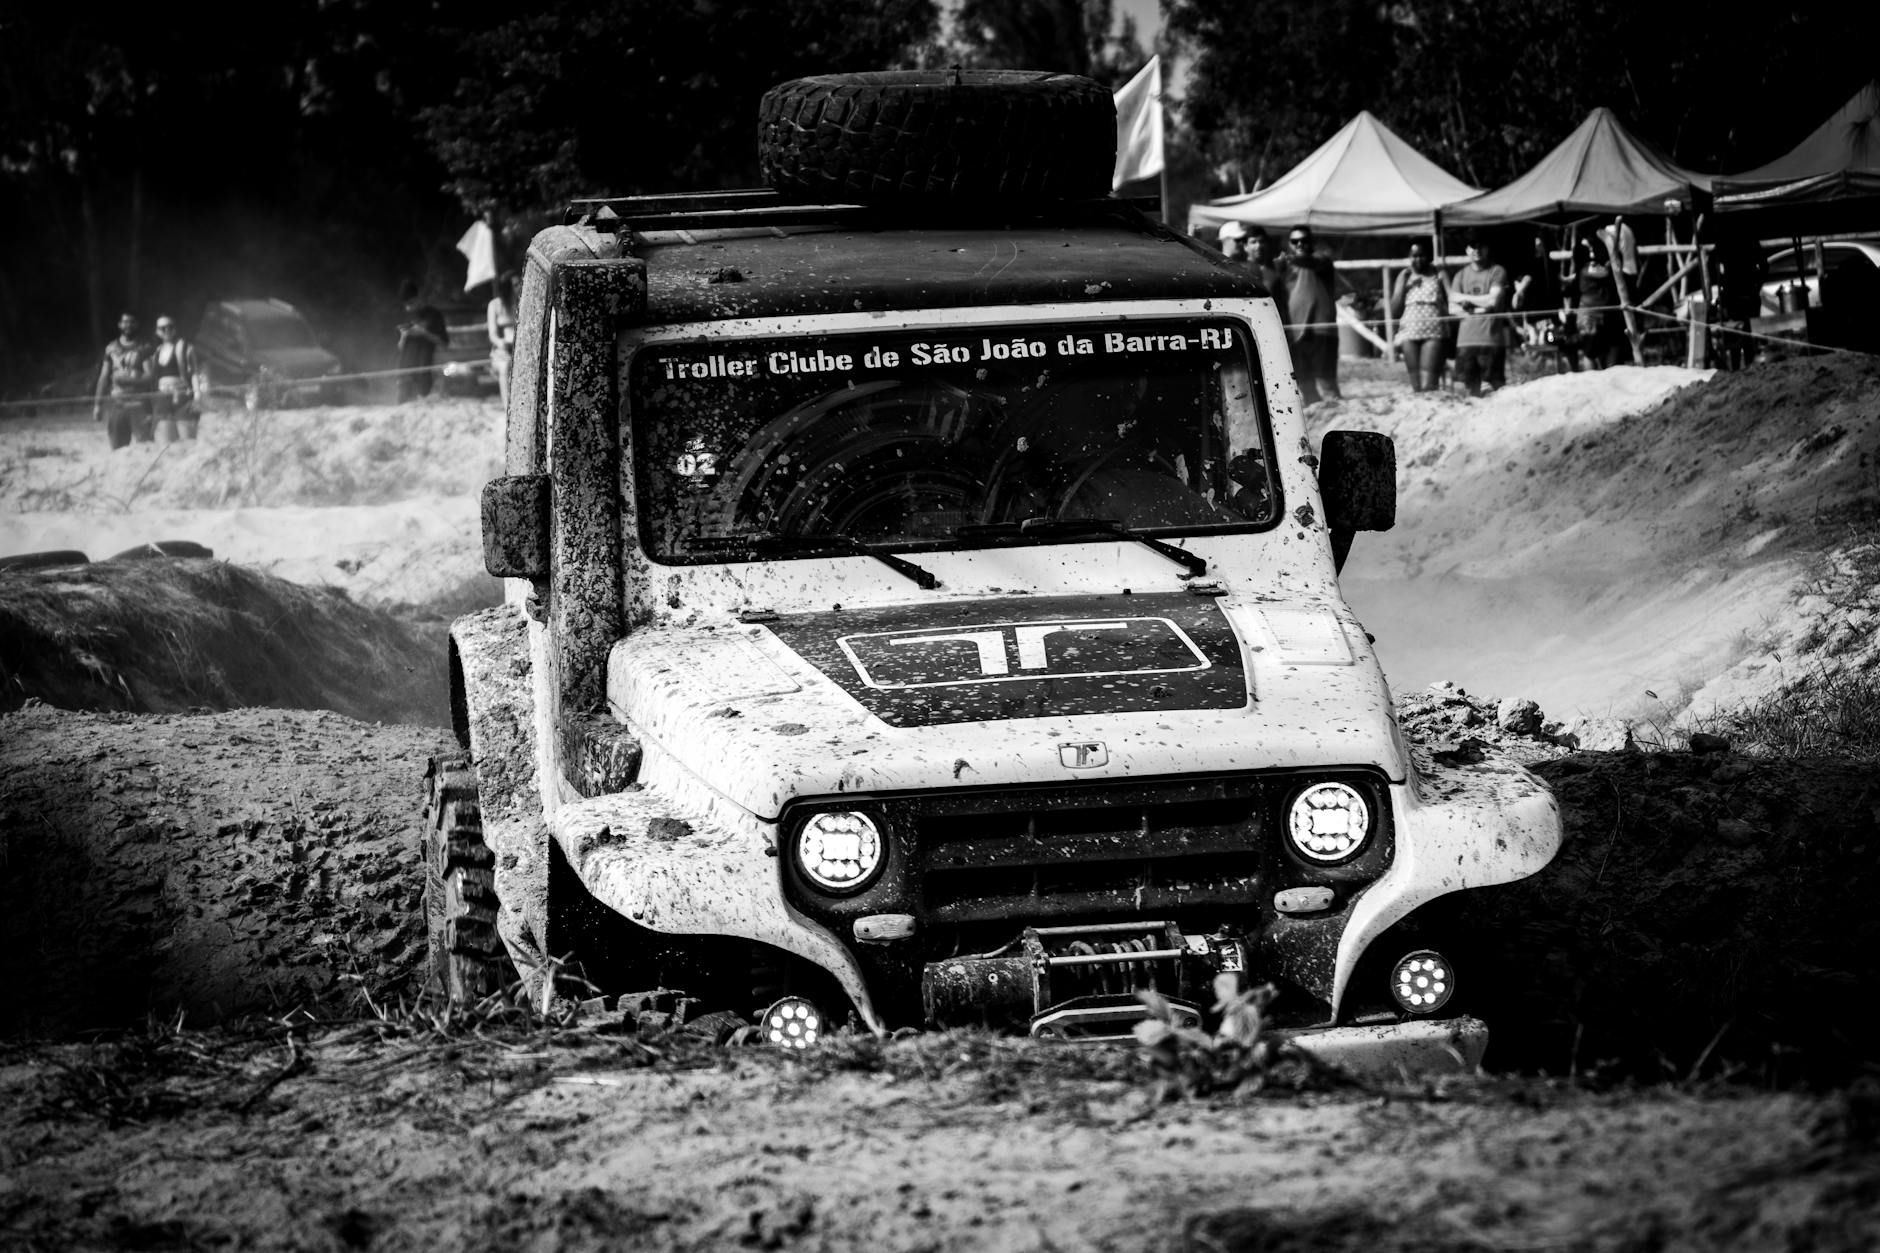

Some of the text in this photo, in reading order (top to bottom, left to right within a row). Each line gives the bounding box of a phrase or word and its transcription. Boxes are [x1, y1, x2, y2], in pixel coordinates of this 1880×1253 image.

[659, 328, 1233, 379] Troller Clube de São João da Barra-RJ
